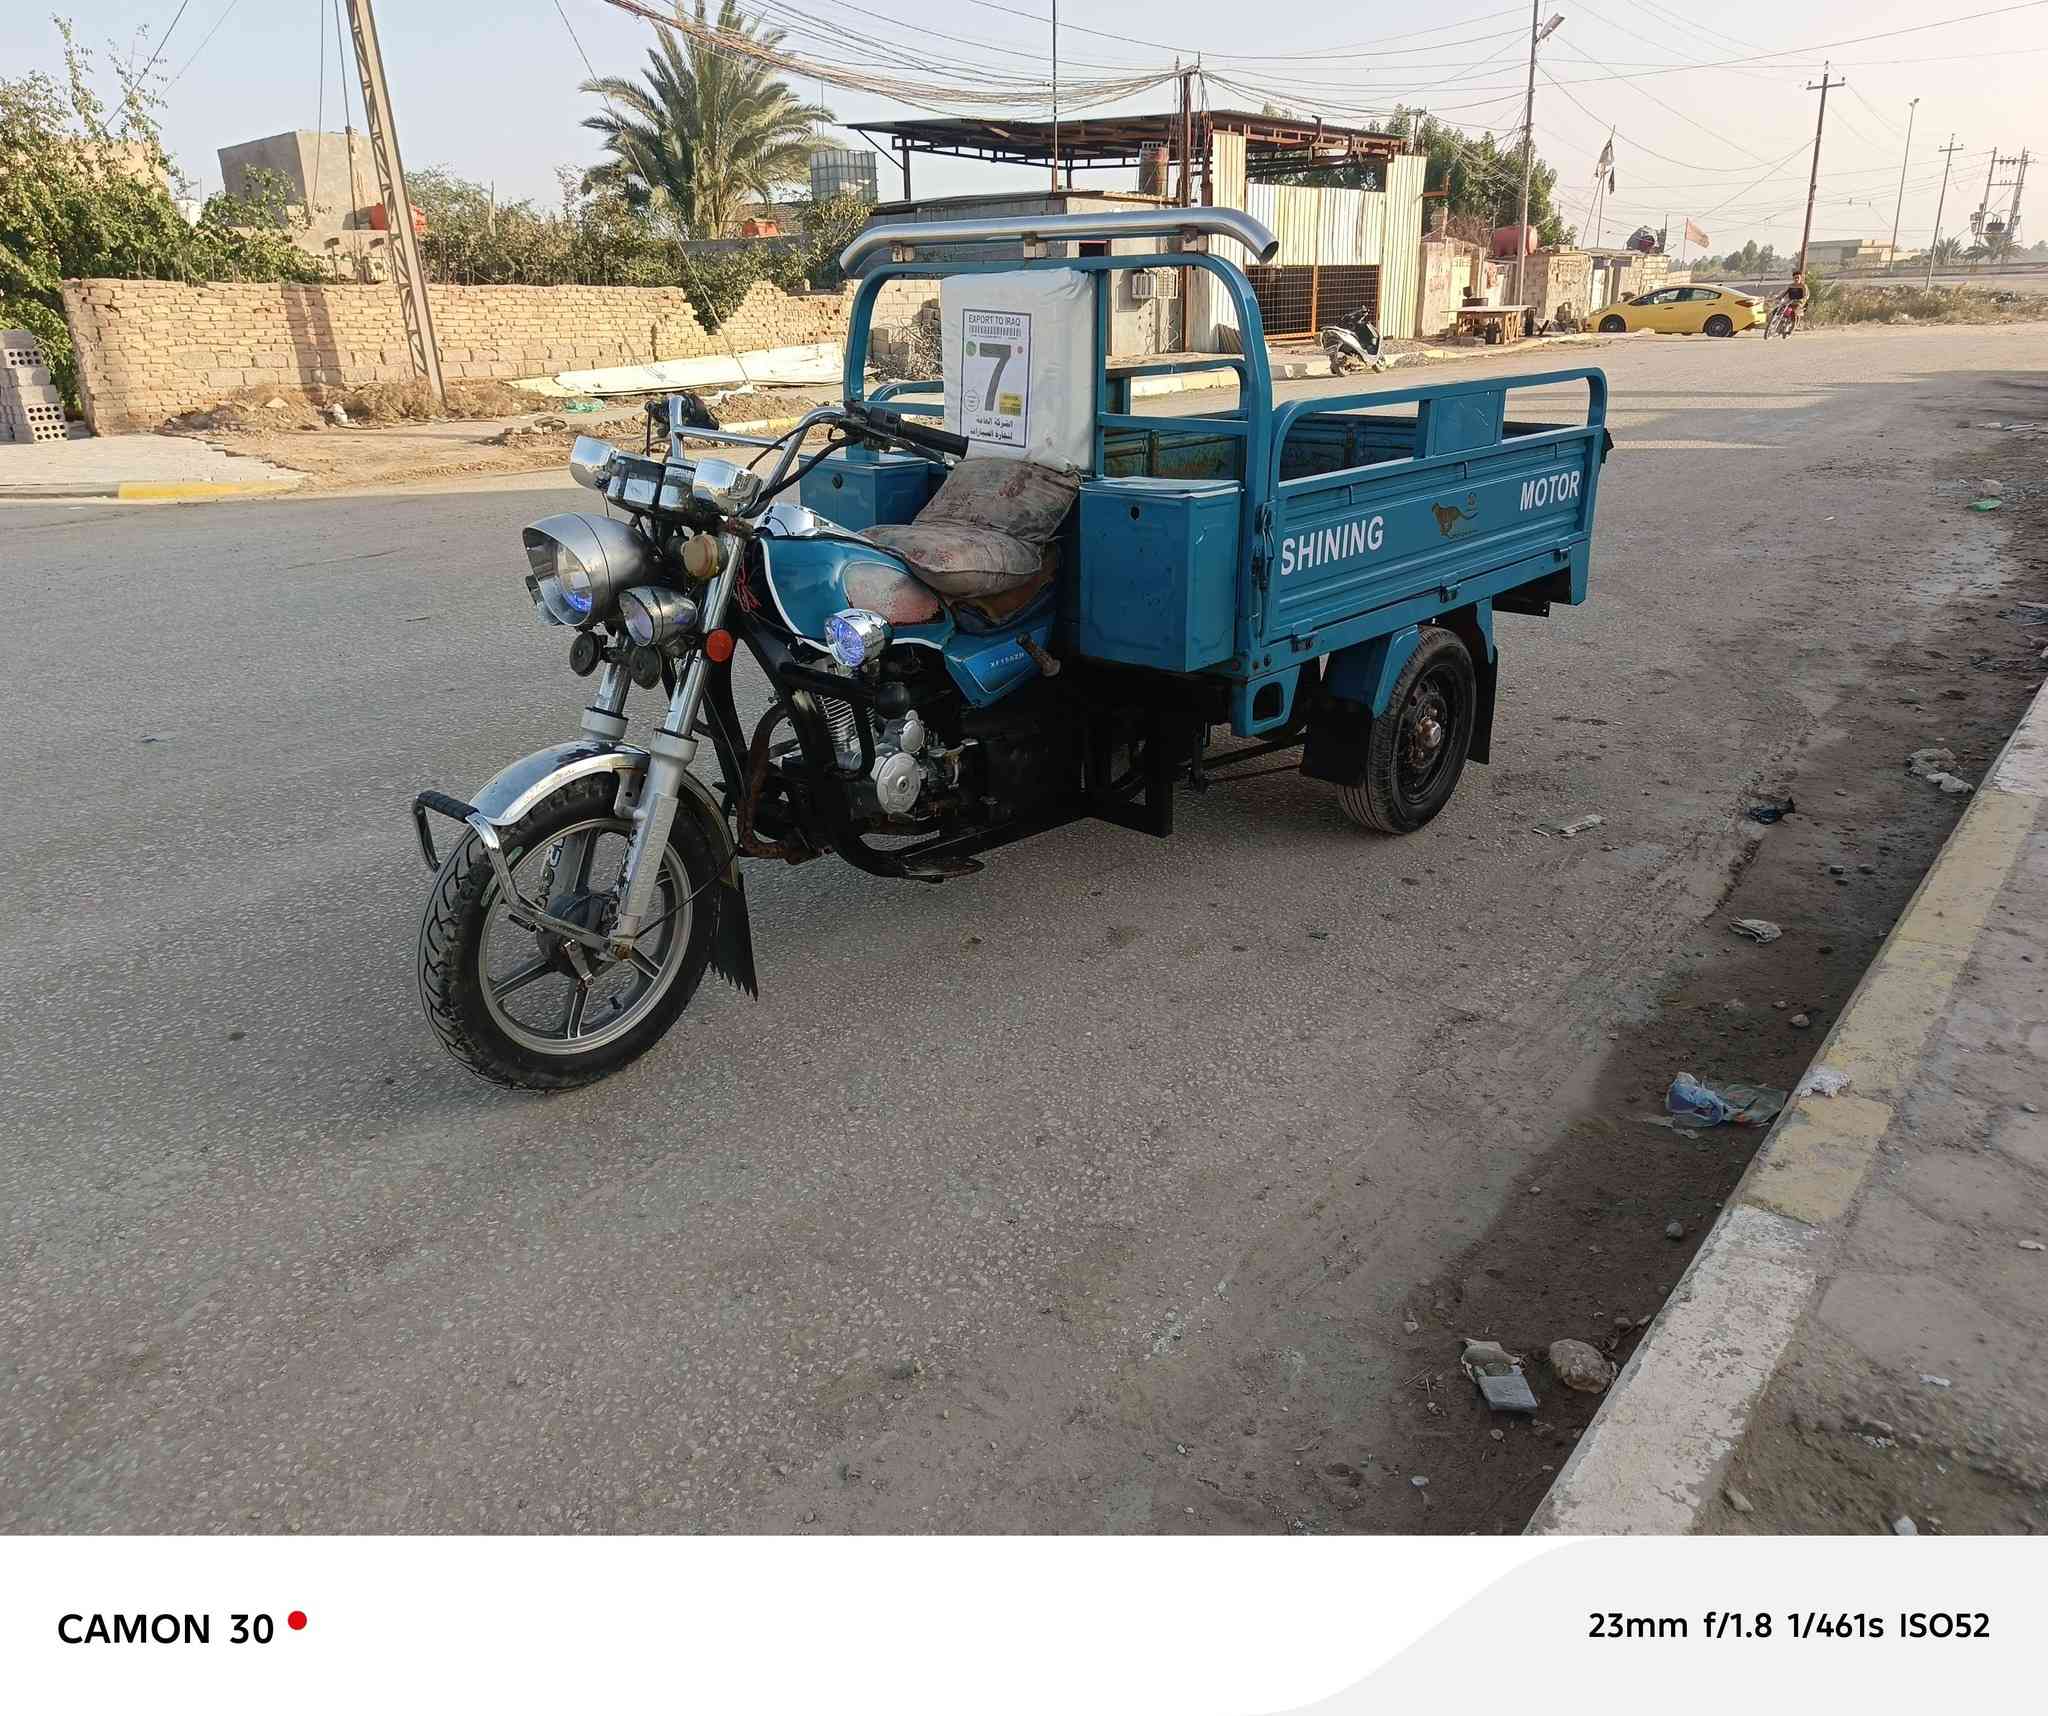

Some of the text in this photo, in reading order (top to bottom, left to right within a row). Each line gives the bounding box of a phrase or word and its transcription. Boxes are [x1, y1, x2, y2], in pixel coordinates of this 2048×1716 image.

[968, 313, 1021, 327] EXPORT TO IRAQ
[979, 342, 1012, 412] 7
[994, 416, 1014, 429] الشركة
[1281, 470, 1580, 576] SHINING MOTOR
